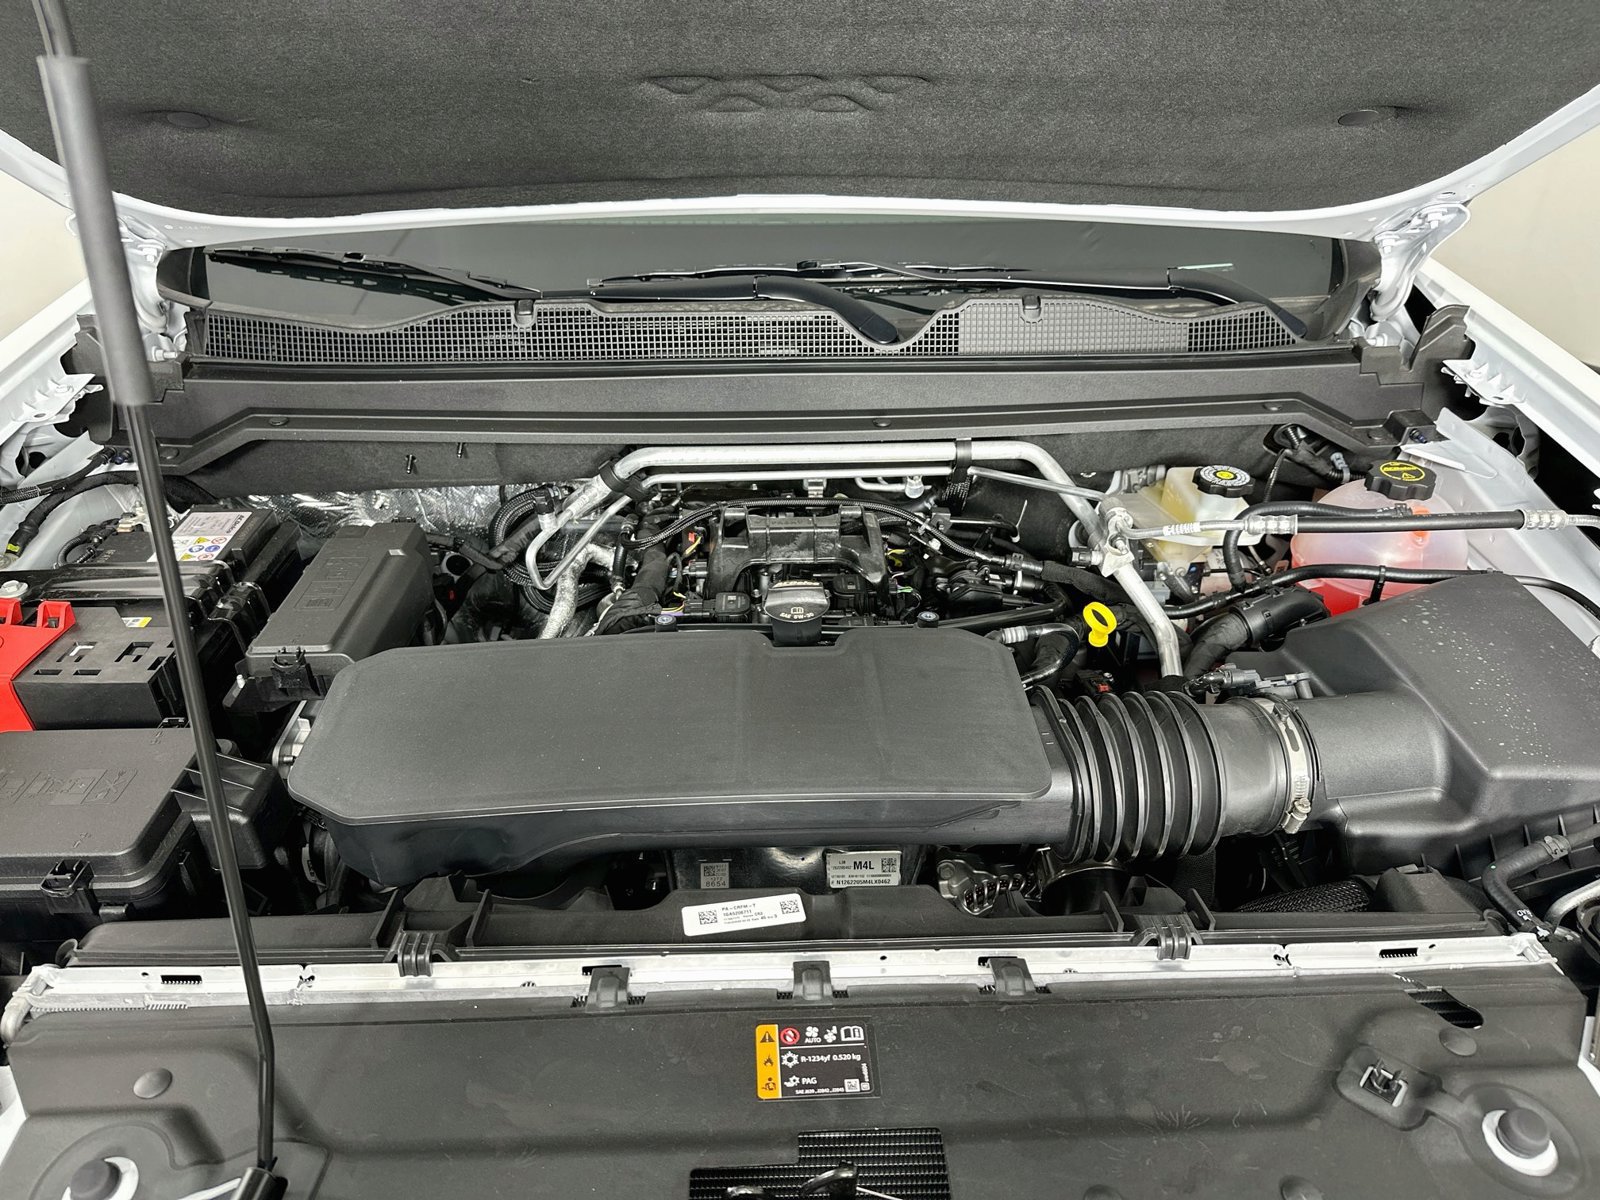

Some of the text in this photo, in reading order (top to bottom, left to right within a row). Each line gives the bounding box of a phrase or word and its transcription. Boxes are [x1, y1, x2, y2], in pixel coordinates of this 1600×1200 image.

[853, 860, 875, 870] M4L
[800, 1054, 831, 1063] R-1234yf
[851, 1053, 862, 1062] kg
[801, 1077, 818, 1085] PAG
